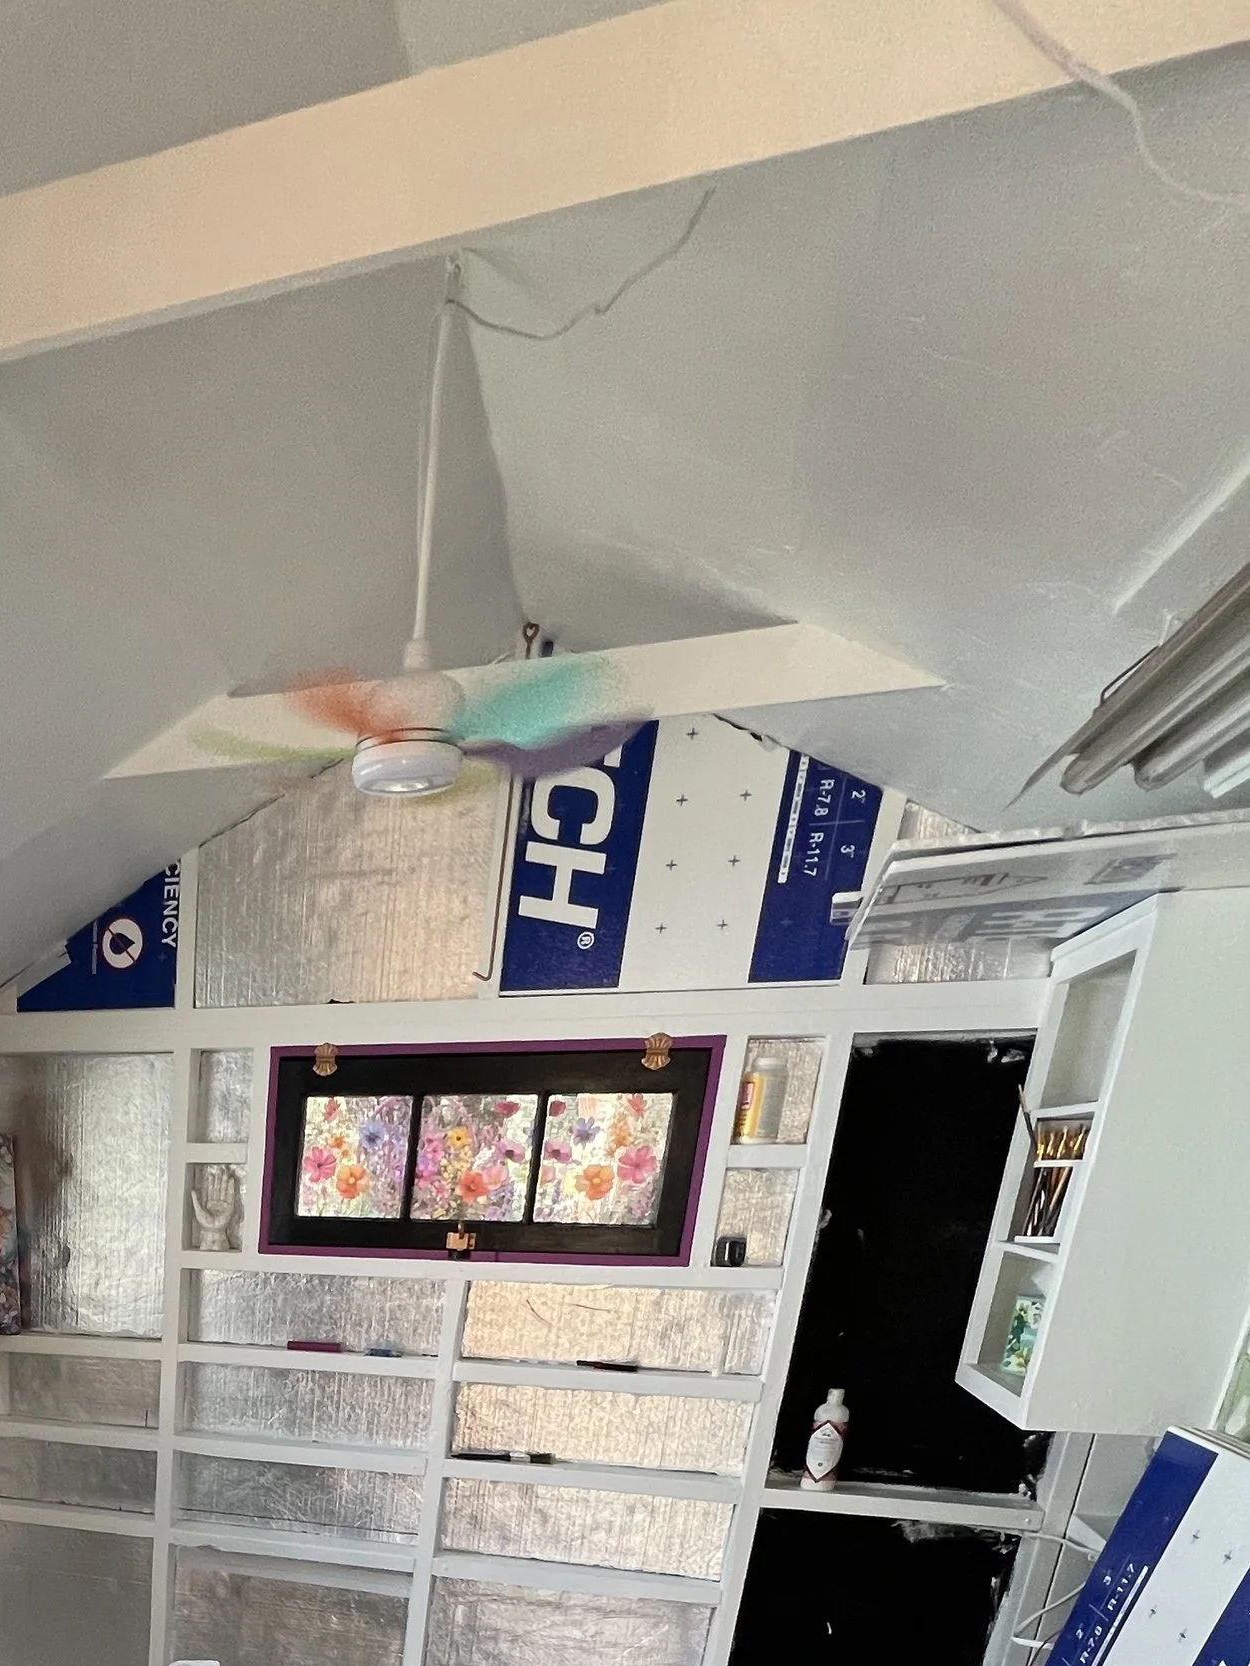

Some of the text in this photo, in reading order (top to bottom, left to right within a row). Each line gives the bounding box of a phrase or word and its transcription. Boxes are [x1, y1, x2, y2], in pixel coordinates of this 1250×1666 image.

[518, 745, 623, 930] CH
[803, 779, 835, 876] R-7.8 R-11.7
